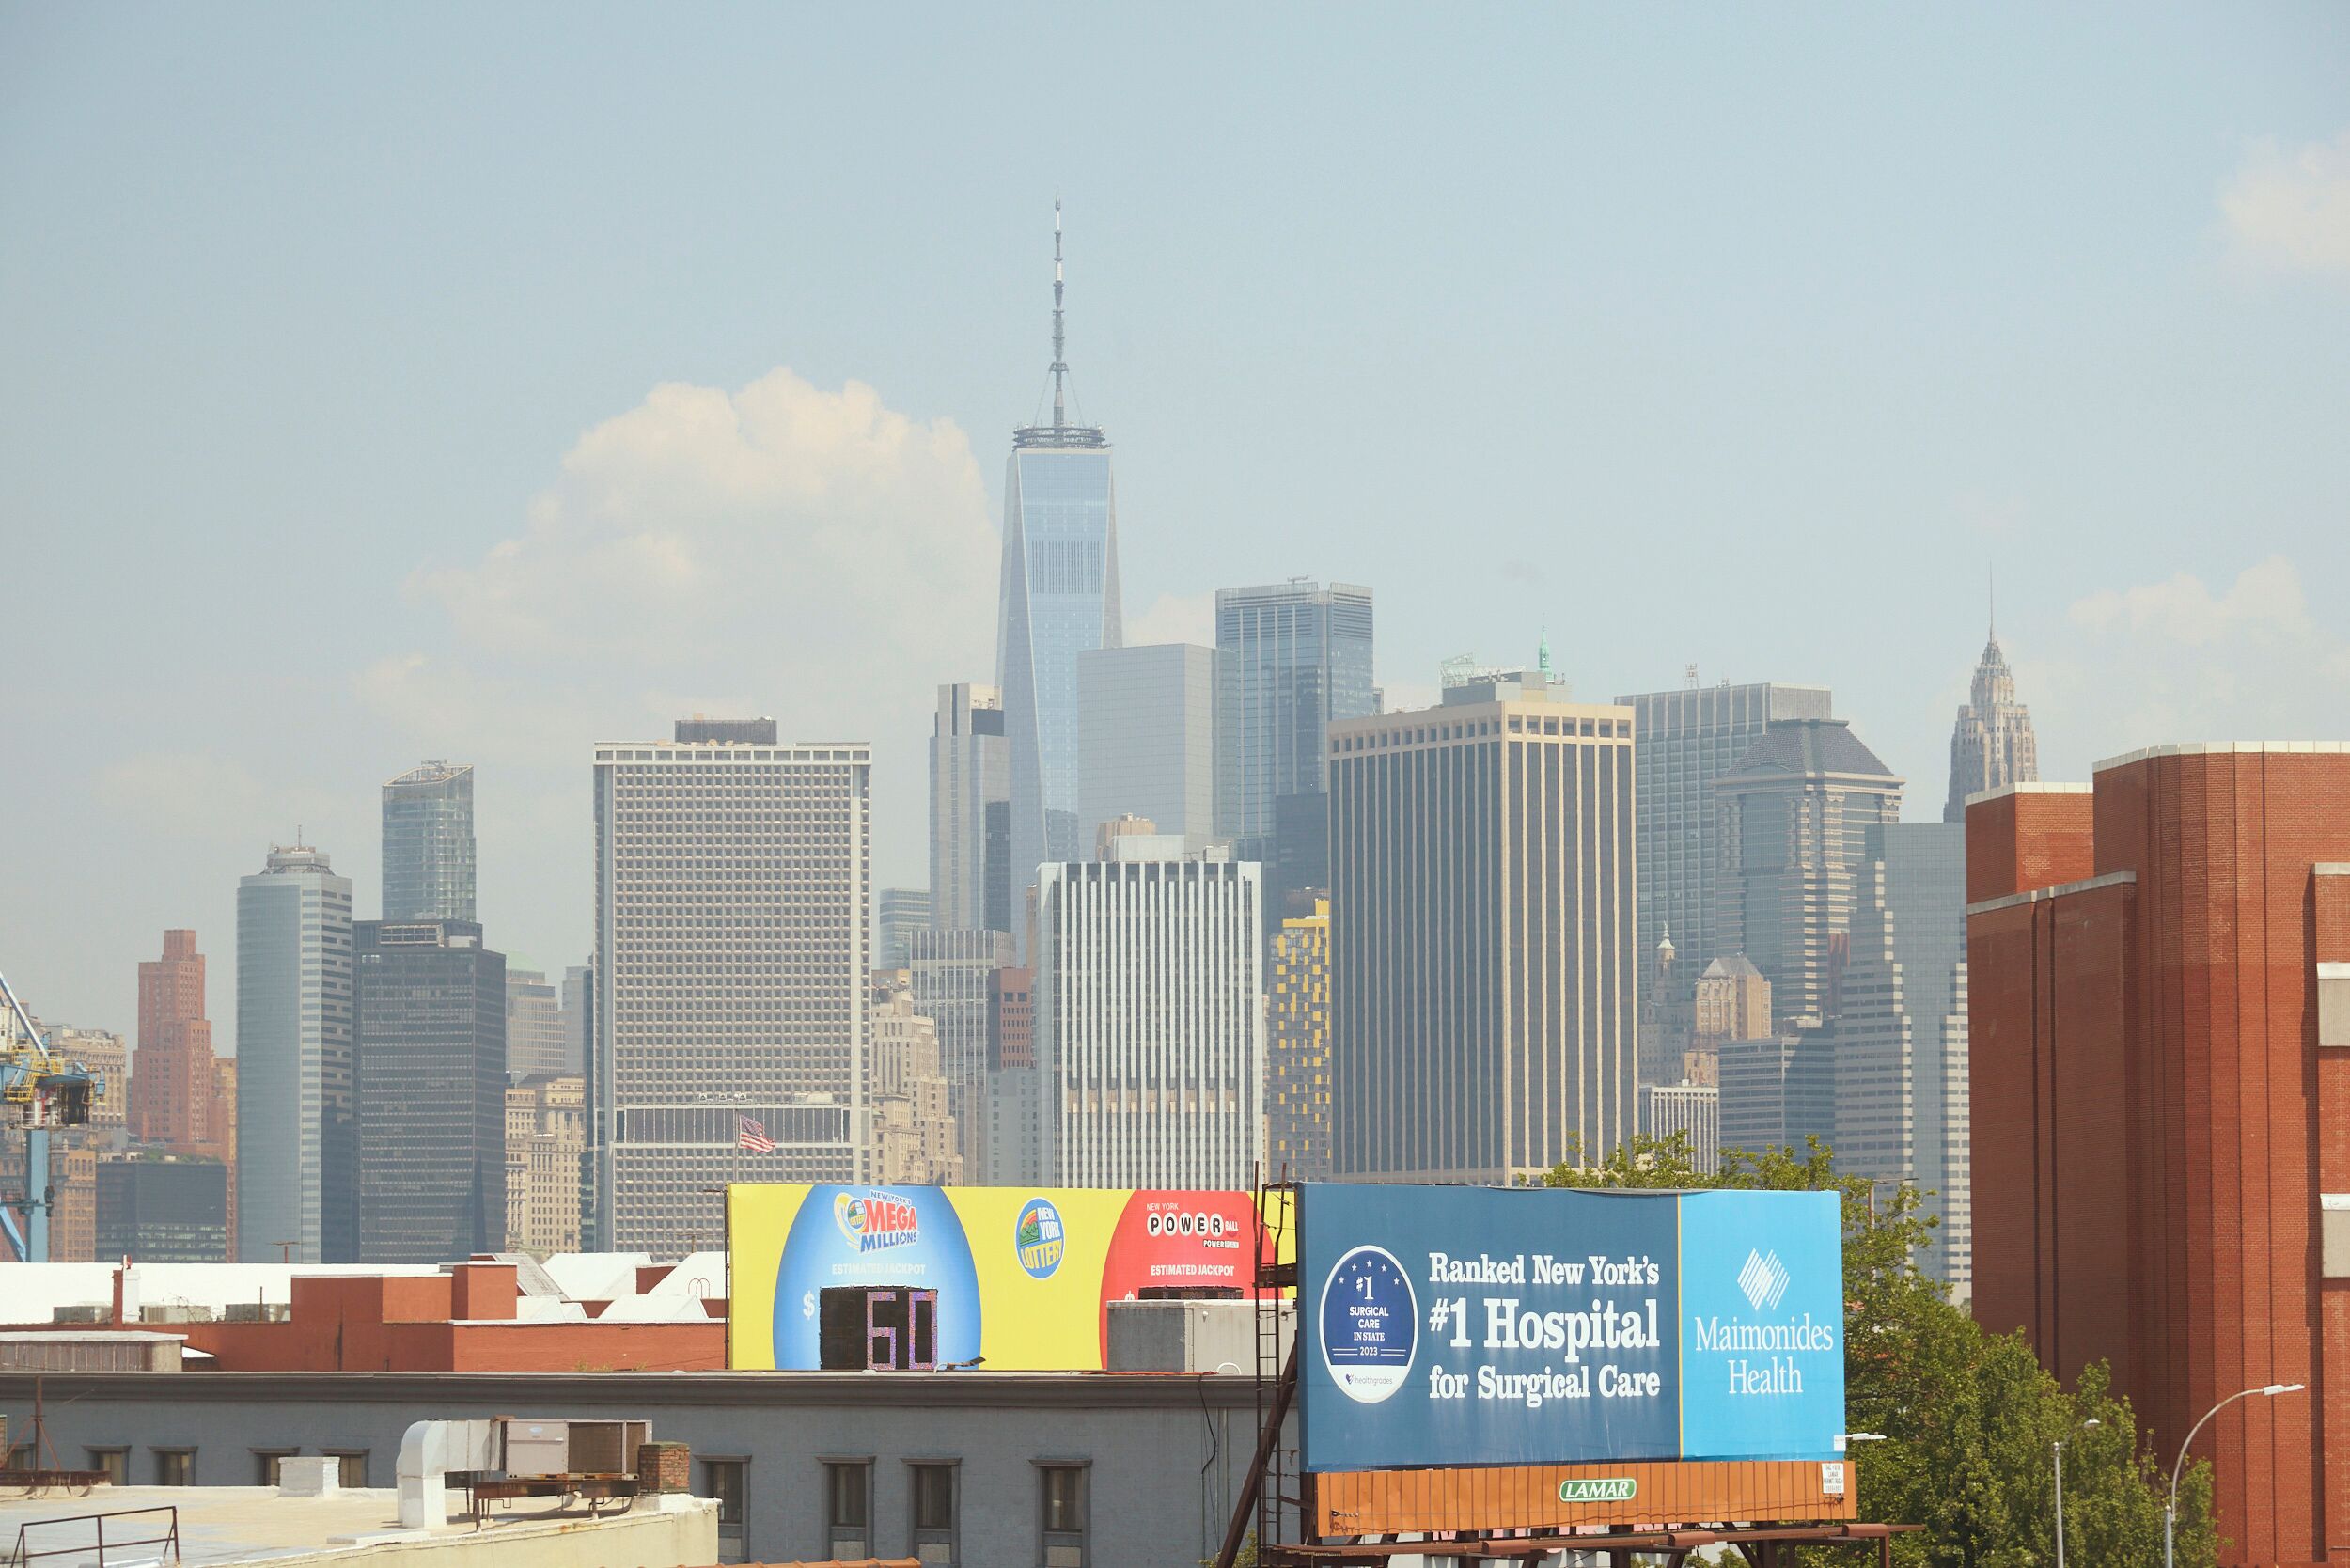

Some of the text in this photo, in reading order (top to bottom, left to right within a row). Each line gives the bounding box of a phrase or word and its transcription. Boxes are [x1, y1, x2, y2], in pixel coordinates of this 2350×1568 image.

[870, 1190, 888, 1200] NEW
[862, 1199, 917, 1233] MEGA
[1037, 1207, 1055, 1220] NEW
[1162, 1202, 1179, 1211] YORK
[1040, 1221, 1061, 1240] YORK
[860, 1231, 917, 1253] MILLIONS
[1020, 1238, 1063, 1269] LOTTERY
[832, 1263, 926, 1276] ESTIMATED JACKPOT
[1151, 1264, 1234, 1277] ESTIMATED JACKPOT
[1429, 1252, 1660, 1285] Ranked New York's
[1355, 1275, 1374, 1300] #1
[803, 1290, 815, 1320] $
[1349, 1306, 1389, 1317] SURGICAL
[867, 1291, 938, 1370] 60
[1357, 1319, 1380, 1329] CARE
[1429, 1297, 1660, 1363] #1 Hospital
[1695, 1313, 1834, 1352] Maimonides
[1353, 1331, 1385, 1341] IN STATE
[1359, 1346, 1378, 1356] 2023
[1355, 1375, 1393, 1386] healthgrades
[1728, 1356, 1804, 1395] Health
[1429, 1365, 1661, 1408] for Surgical Care
[1565, 1482, 1629, 1498] LAMAR
